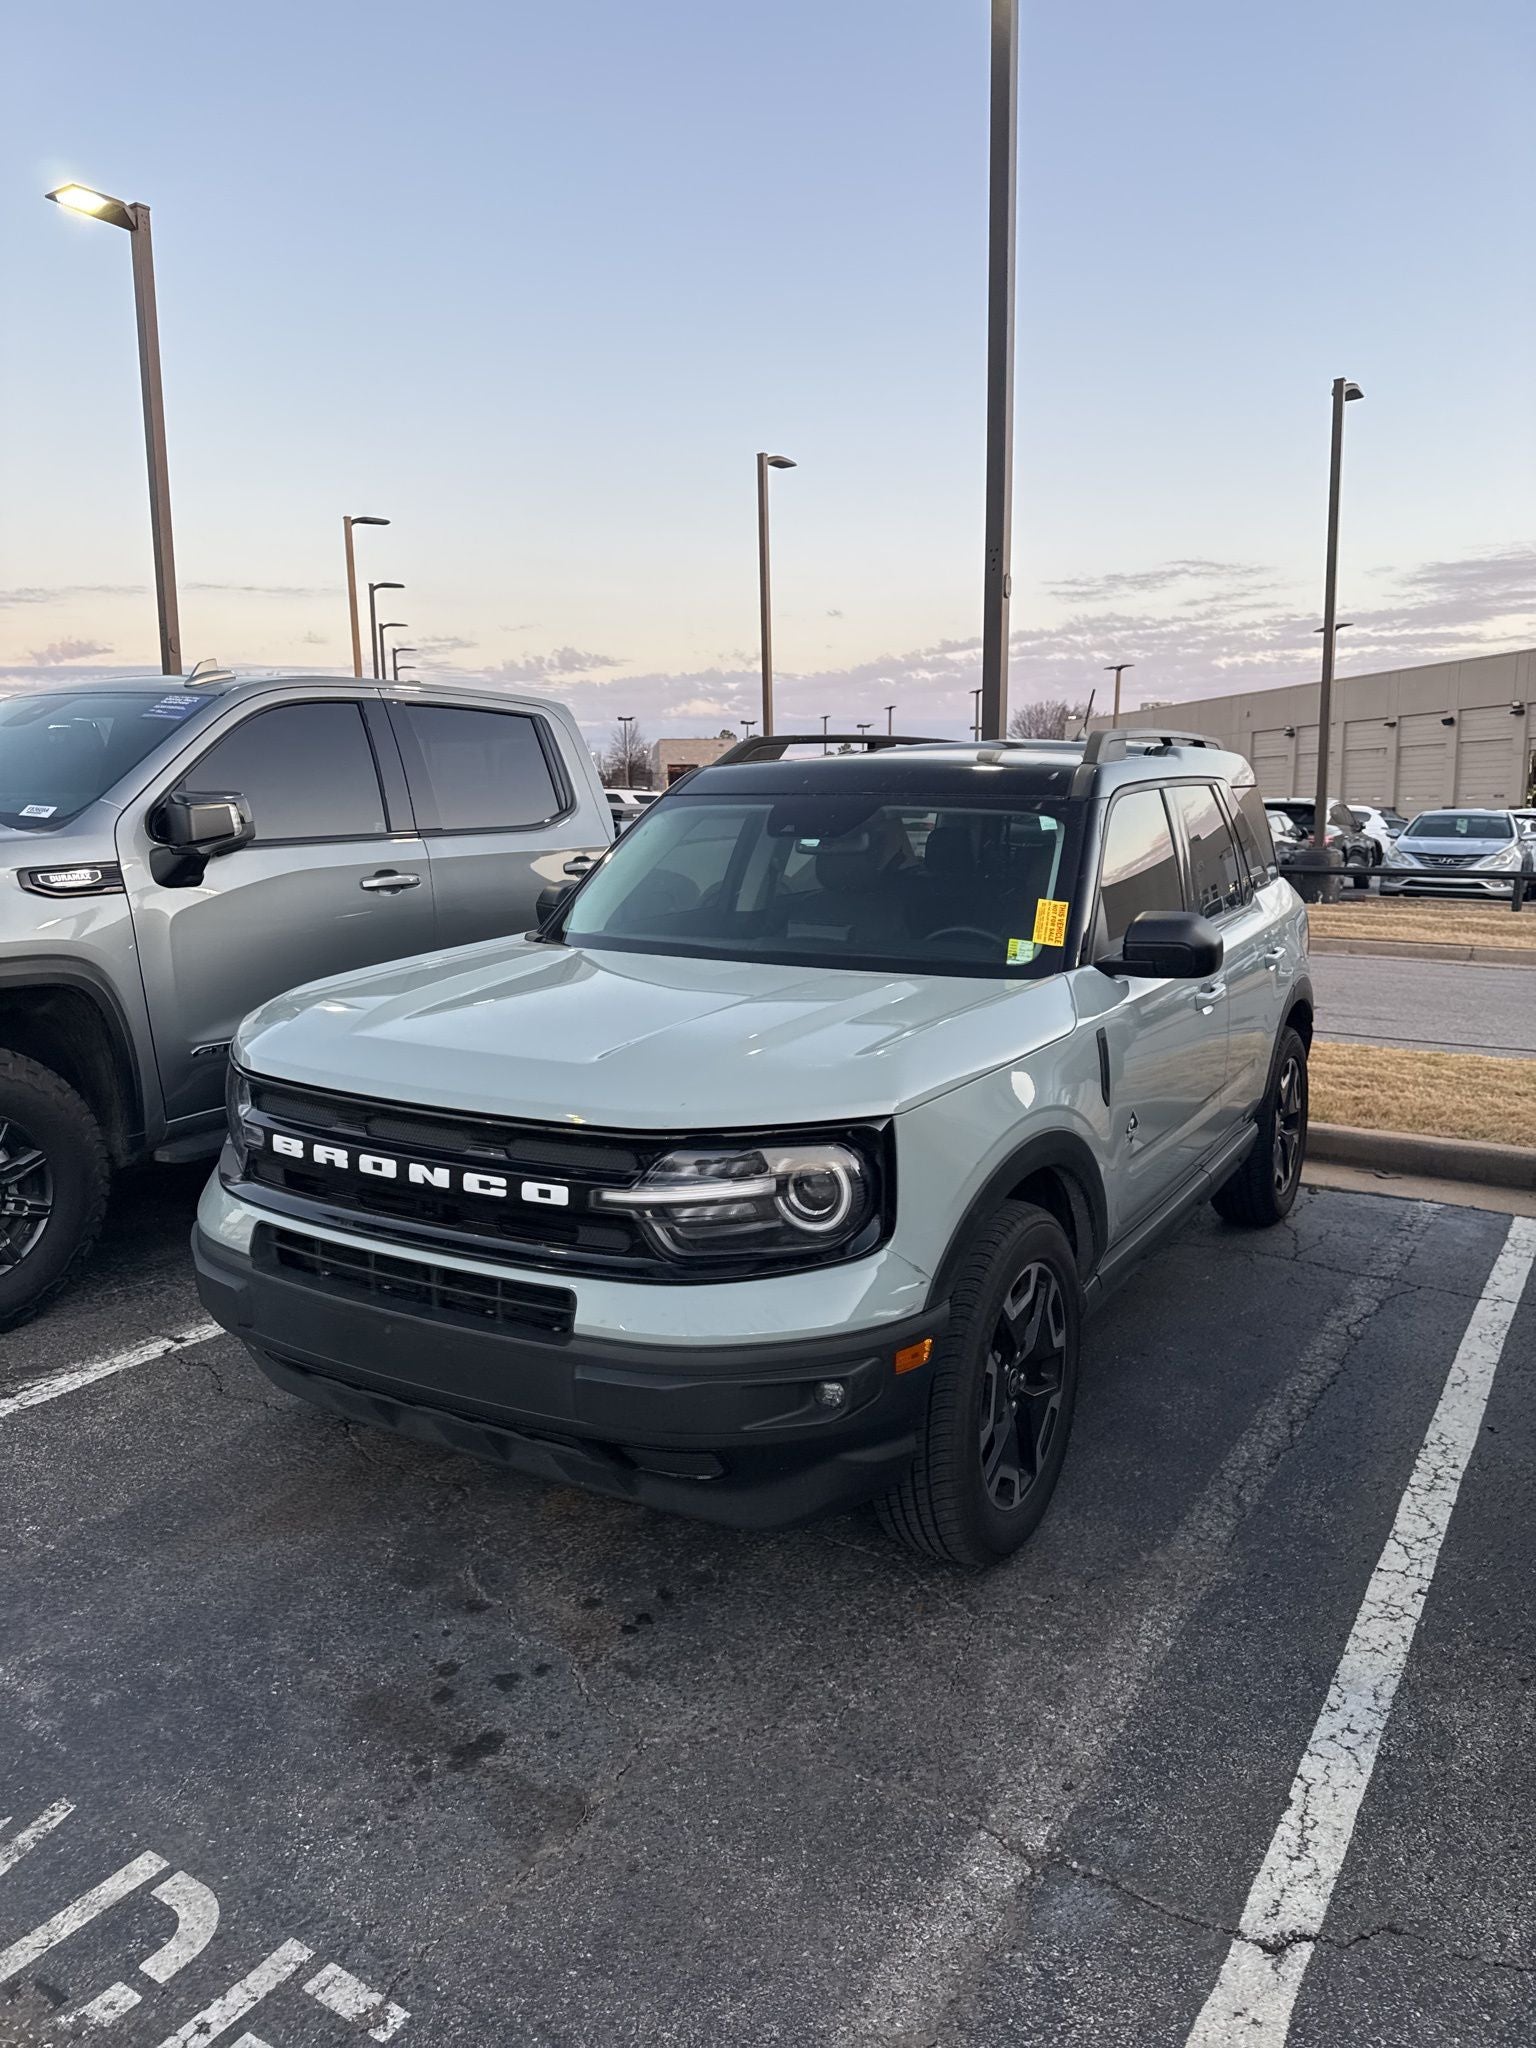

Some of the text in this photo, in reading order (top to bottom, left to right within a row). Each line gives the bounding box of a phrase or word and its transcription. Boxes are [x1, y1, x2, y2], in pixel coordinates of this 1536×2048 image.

[49, 873, 92, 883] DURAMAX
[1047, 927, 1055, 942] SALE
[1054, 903, 1067, 945] THIS VEHICLE
[272, 1133, 570, 1206] BRONCO
